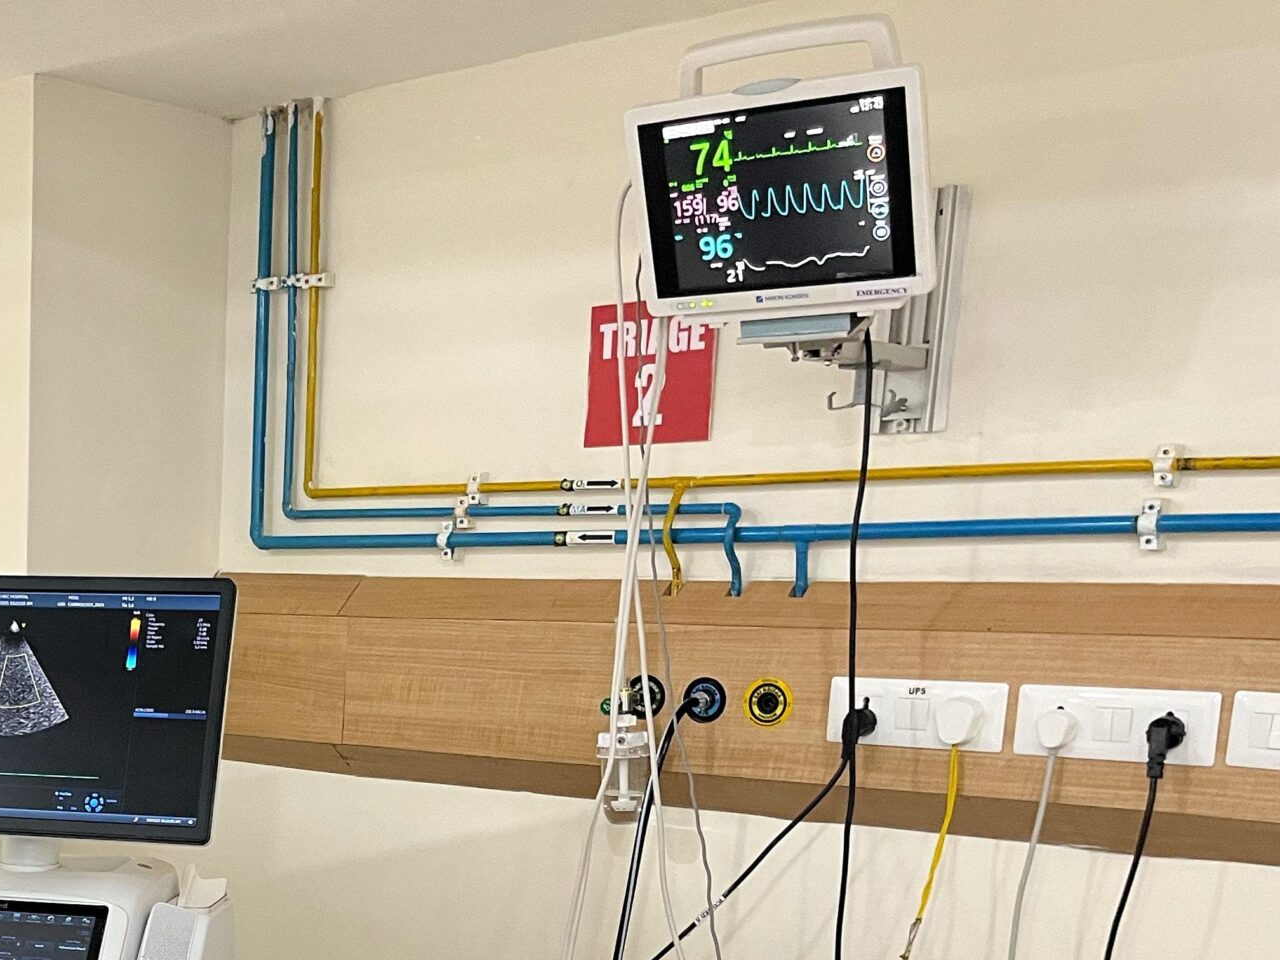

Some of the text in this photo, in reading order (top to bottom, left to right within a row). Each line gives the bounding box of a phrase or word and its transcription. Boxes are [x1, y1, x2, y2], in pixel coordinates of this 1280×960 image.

[689, 140, 732, 175] 74
[717, 193, 739, 212] 96
[698, 234, 734, 261] 96
[856, 287, 908, 297] EMERGENCY
[632, 363, 666, 427] 2
[908, 687, 926, 695] UPS
